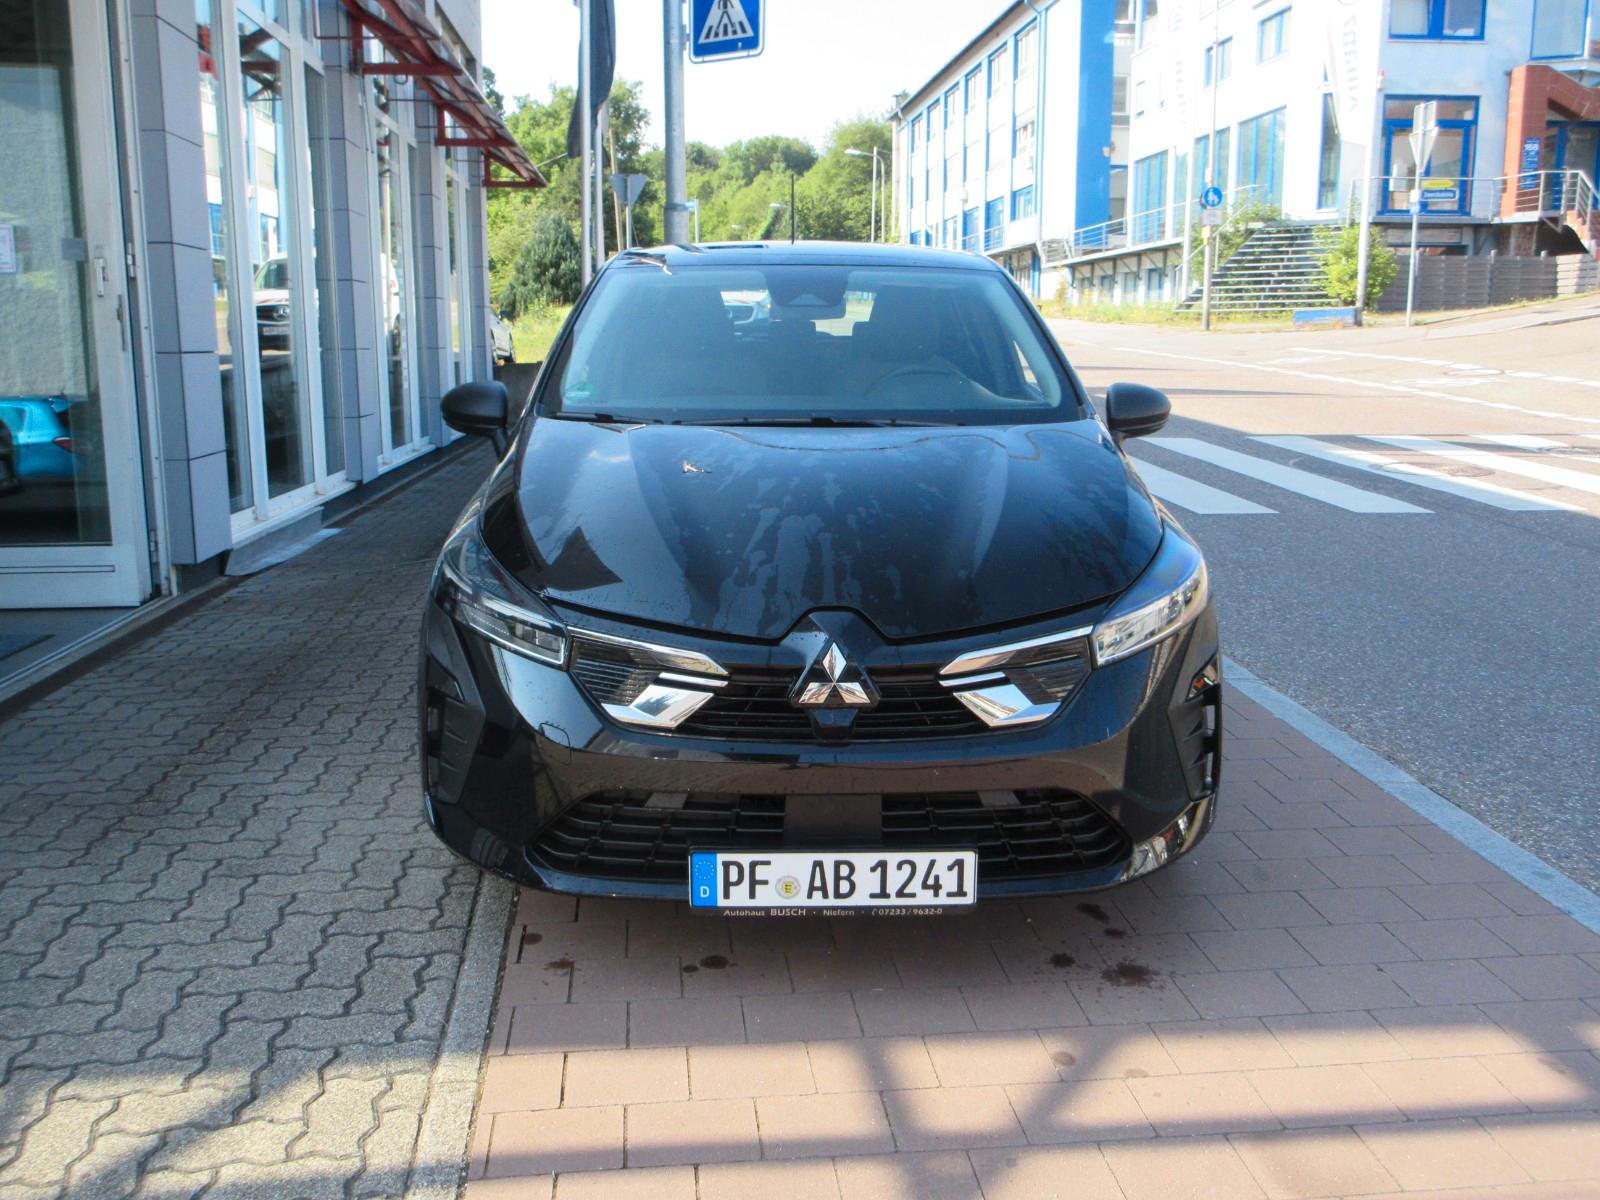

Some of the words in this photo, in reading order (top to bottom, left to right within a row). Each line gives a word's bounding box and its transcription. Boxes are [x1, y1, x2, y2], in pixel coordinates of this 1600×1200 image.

[722, 860, 772, 900] PF
[806, 860, 856, 900] AB
[869, 858, 968, 900] 1241
[700, 886, 710, 898] D
[723, 909, 765, 917] Autohaus
[770, 908, 807, 917] BUSCH
[823, 909, 855, 917] Niefern
